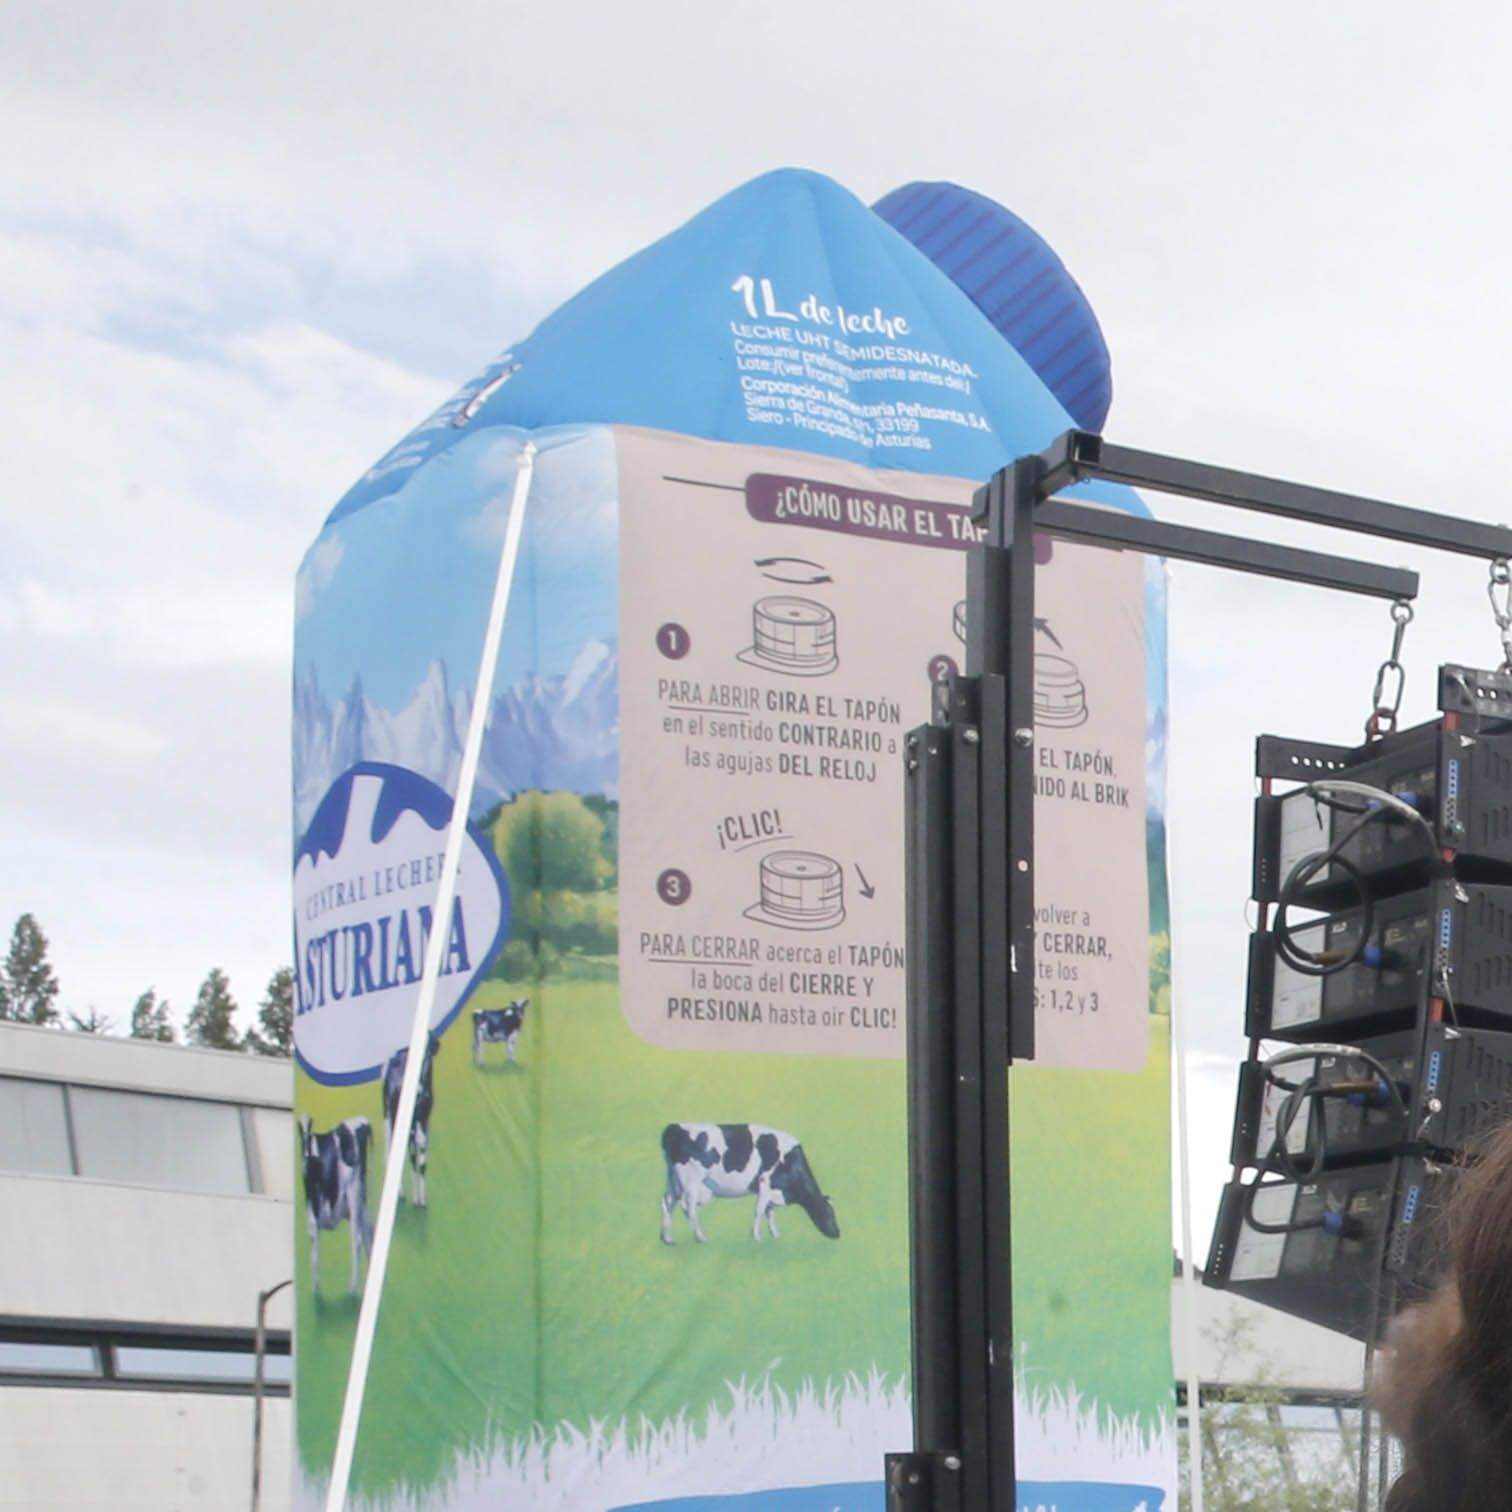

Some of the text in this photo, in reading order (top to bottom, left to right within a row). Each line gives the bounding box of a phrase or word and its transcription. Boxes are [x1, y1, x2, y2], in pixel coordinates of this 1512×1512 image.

[800, 294, 834, 326] de
[837, 306, 911, 340] leche
[730, 321, 793, 342] LECHE
[796, 327, 832, 350] UHT
[734, 339, 801, 361] Consumir
[740, 376, 827, 406] Corporación
[743, 391, 785, 410] Sierra
[787, 397, 805, 413] de
[876, 417, 920, 434] 33199
[746, 407, 784, 425] Siero
[875, 430, 932, 450] Asturias
[775, 484, 841, 522] ¿CÓMO
[847, 501, 909, 534] USAR
[914, 511, 943, 538] EL
[667, 631, 678, 651] 1
[658, 678, 901, 724] PARA ABRIR GIRA EL TAPÓN
[663, 714, 897, 754] en el sentido CONTRARIO a
[685, 746, 876, 783] las agujas DEL RELOJ
[1039, 748, 1058, 770] EL
[1070, 783, 1090, 802] AL
[1094, 784, 1129, 808] BRIK
[717, 808, 784, 850] ¡CLIC!
[306, 875, 367, 921] CENTRAL
[666, 875, 685, 896] 3
[1081, 911, 1090, 926] a
[640, 932, 904, 969] PARA CERRAR acerca el TAPÓN
[1043, 932, 1113, 961] CERRAR,
[691, 968, 874, 997] la boca del CIERRE Y
[1058, 960, 1078, 981] los
[667, 997, 762, 1023] PRESIONA
[768, 1003, 816, 1026] hasta
[850, 1006, 897, 1029] CLIC!
[1078, 997, 1086, 1014] y
[1089, 991, 1098, 1012] 3
